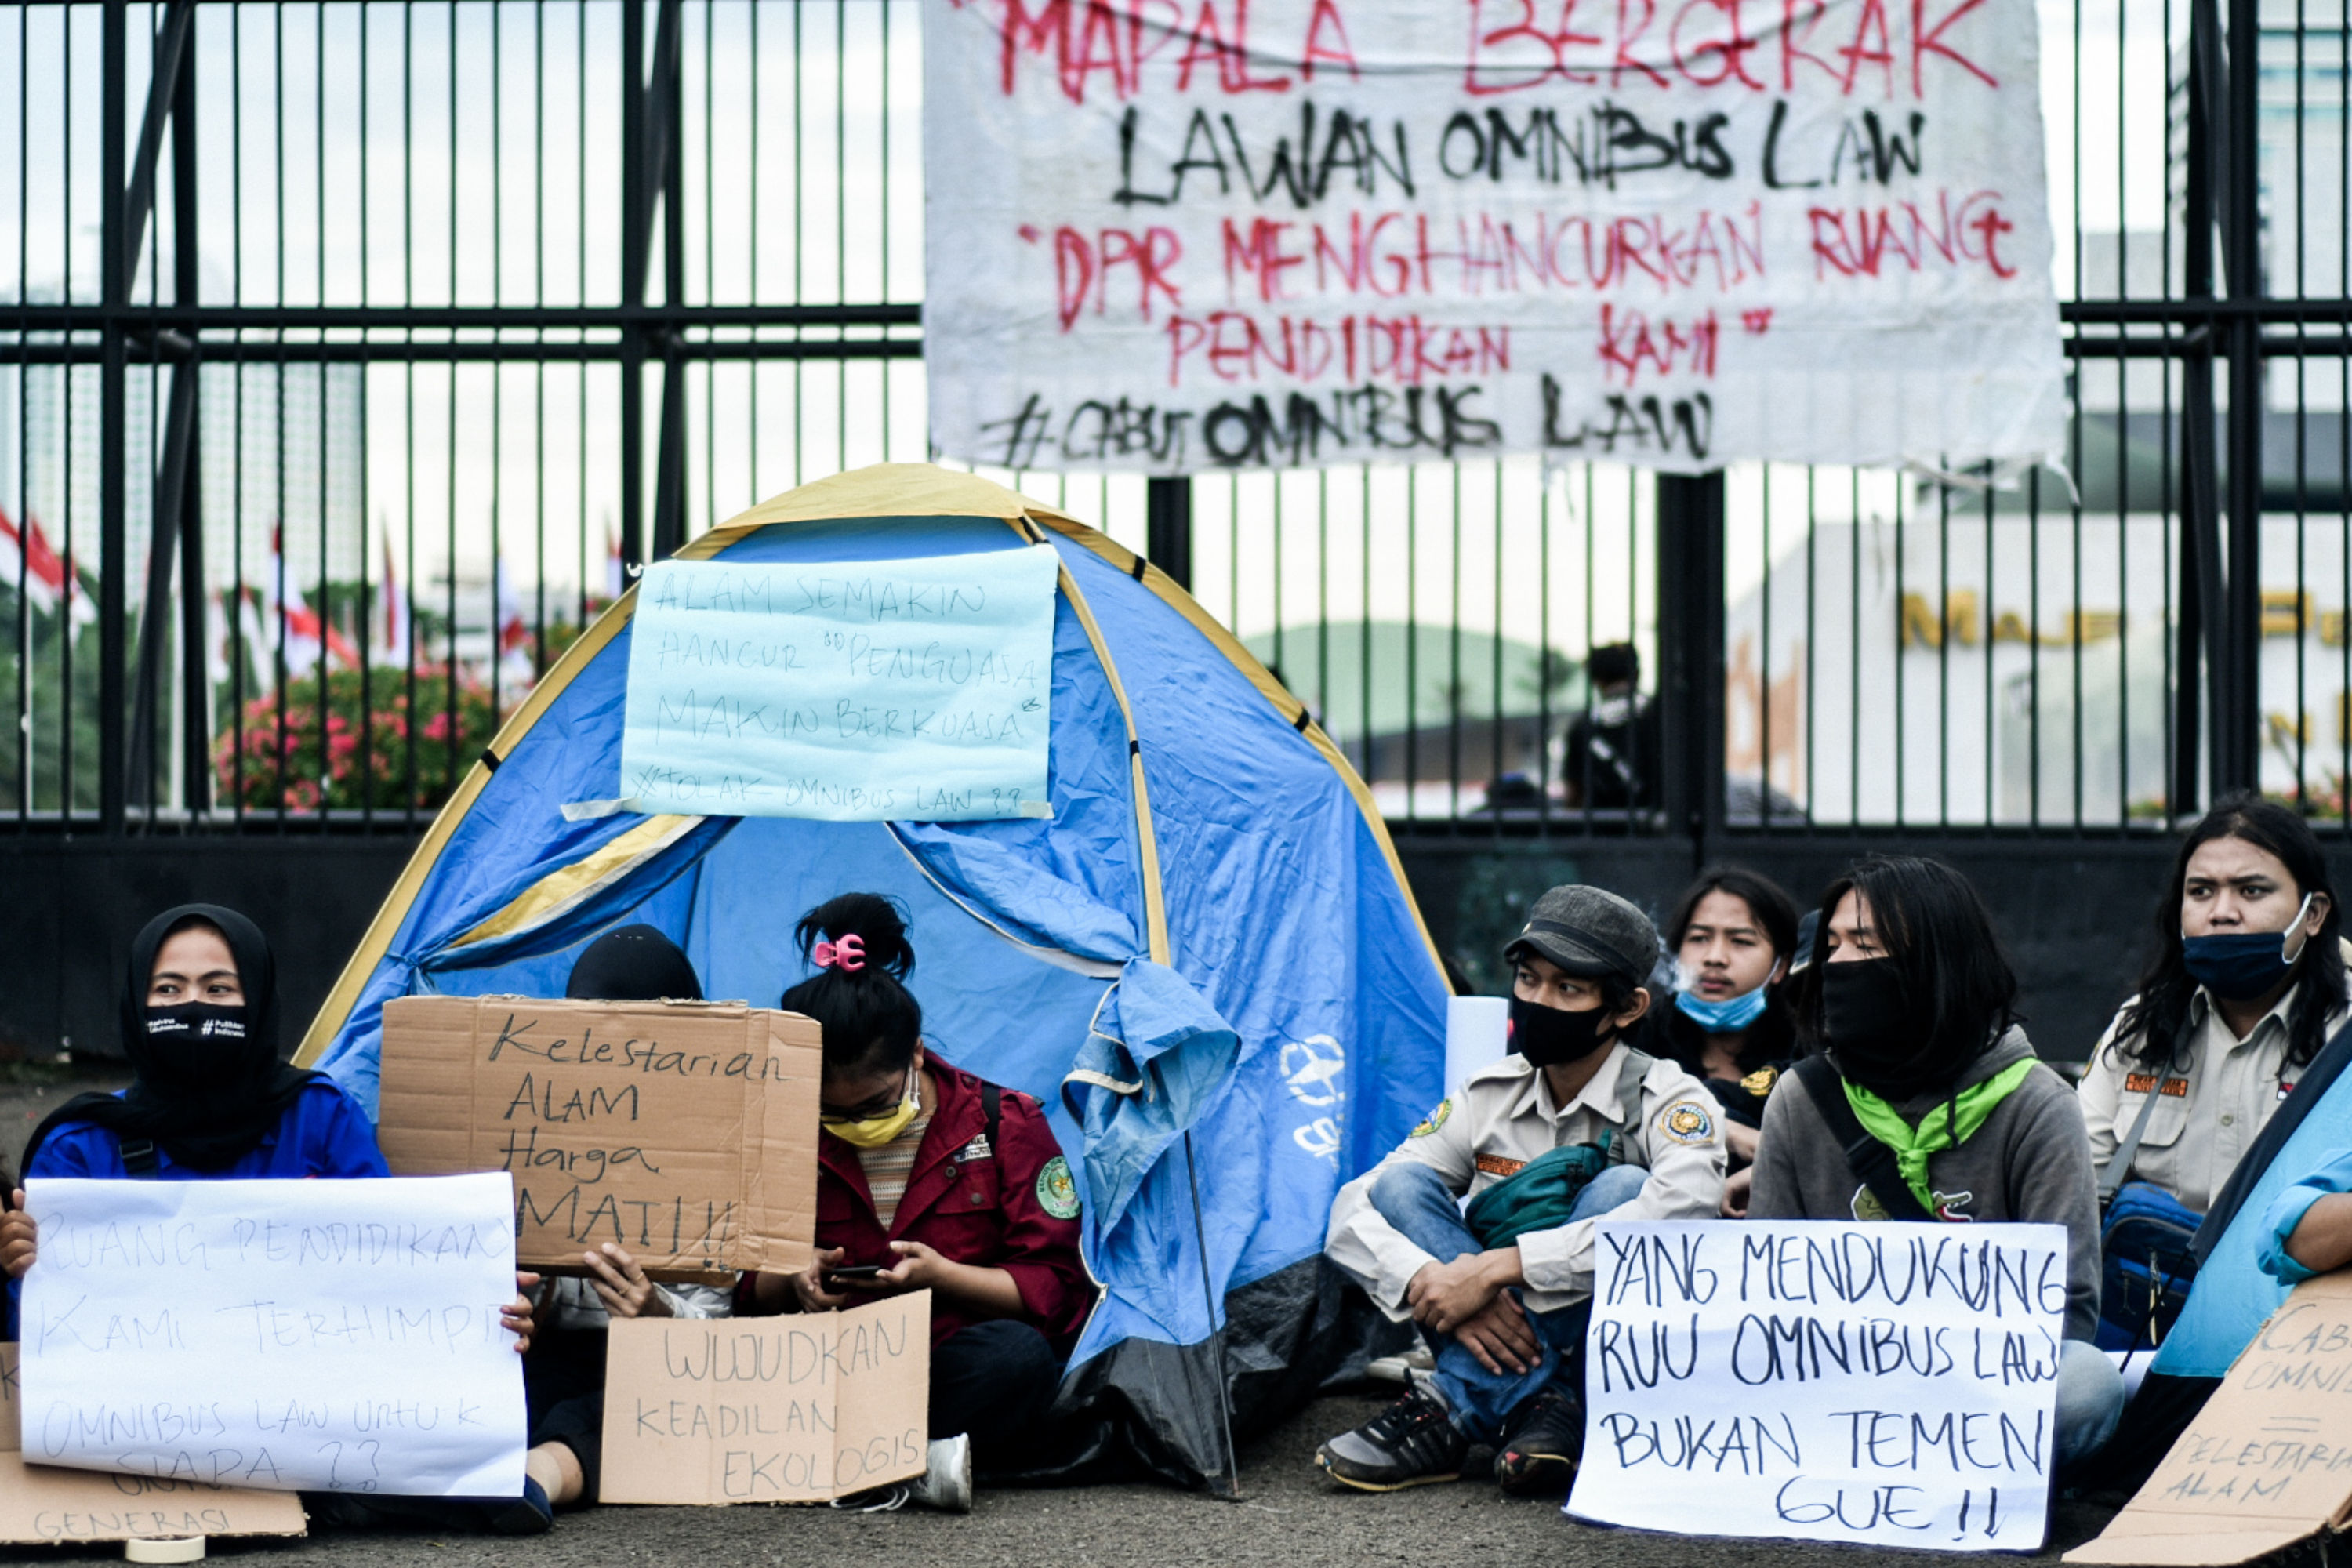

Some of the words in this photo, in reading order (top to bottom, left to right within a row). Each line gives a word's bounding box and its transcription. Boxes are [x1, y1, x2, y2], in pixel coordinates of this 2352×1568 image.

[999, 0, 1361, 105] MAPALA
[1112, 100, 1416, 209] LAWAN
[1439, 100, 1734, 190] OMNIBUS
[1762, 100, 1925, 188] LAW
[1221, 199, 1764, 303] MENGHANCURKAN
[1167, 311, 1510, 387] PENDIDIKAN
[1542, 373, 1712, 461] LAW
[655, 573, 772, 615] ALAM
[793, 577, 985, 617] SEMAKIN
[658, 630, 807, 672] HANCUR
[654, 689, 819, 745] MAKIN
[785, 776, 895, 811] OMNIBUS
[916, 787, 971, 811] LAW
[488, 1014, 786, 1082] Kelestarian
[503, 1073, 640, 1123] ALAM
[499, 1127, 660, 1184] Harga
[36, 1211, 212, 1270] RUANG
[232, 1217, 513, 1269] PENDIDIKAN
[1602, 1232, 1718, 1308] YANG
[1740, 1232, 2067, 1317] MENDUKUNG
[665, 1314, 906, 1385] WUJUDKAN
[1594, 1313, 1700, 1393] RUU
[1973, 1324, 2059, 1386] LAW
[2259, 1303, 2352, 1355] CAB
[42, 1399, 226, 1459] OMNIBUS
[255, 1400, 329, 1433] LAW
[637, 1399, 837, 1438] KEADILAN
[1600, 1412, 1801, 1475] BUKAN
[1828, 1409, 2043, 1475] TEMEN
[721, 1428, 920, 1497] EKOLOGIS
[2158, 1470, 2292, 1505] ALAM
[34, 1508, 231, 1538] GENERASI
[1775, 1475, 1933, 1531] GUE
